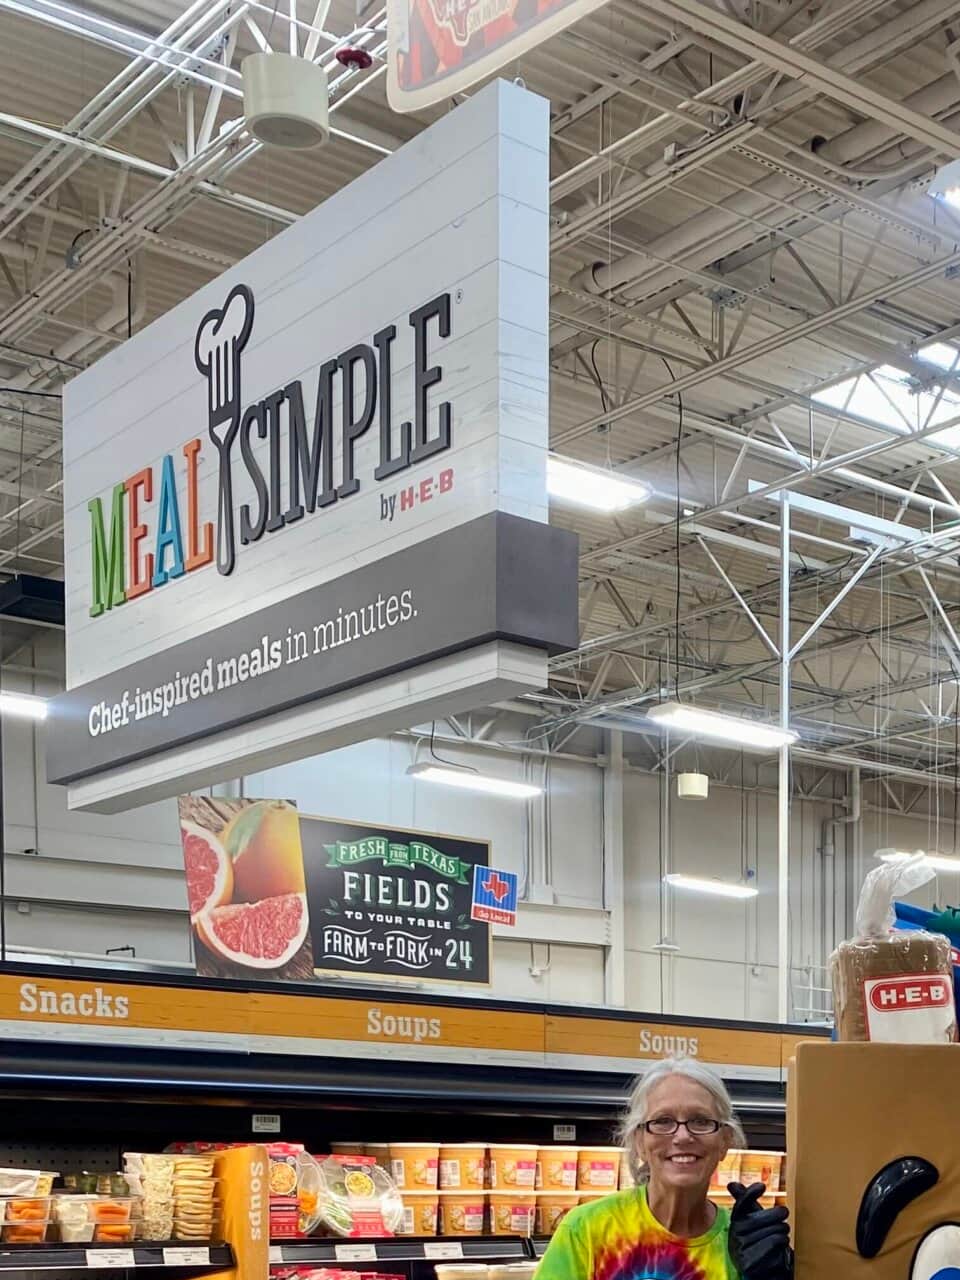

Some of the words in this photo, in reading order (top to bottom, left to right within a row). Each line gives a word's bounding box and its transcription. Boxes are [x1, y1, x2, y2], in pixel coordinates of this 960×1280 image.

[88, 439, 213, 617] MEAL
[239, 293, 451, 546] SIMPLE
[379, 490, 397, 520] by
[88, 658, 214, 737] Chef-inspired
[216, 635, 283, 691] meals
[285, 627, 309, 665] in
[312, 589, 419, 655] minutes.
[339, 840, 386, 860] FRESH
[412, 844, 456, 875] TEXAS
[343, 871, 450, 912] FIELDS
[344, 911, 363, 921] TO
[367, 912, 403, 924] YOUR
[407, 917, 451, 930] TABLE
[323, 930, 368, 959] FARM
[369, 941, 385, 951] TO
[385, 935, 429, 964] FORK
[429, 946, 443, 957] IN
[445, 938, 473, 970] 24
[19, 982, 129, 1018] Snacks
[367, 1008, 441, 1041] Soups
[639, 1030, 698, 1056] Soups
[250, 1161, 265, 1241] Soups
